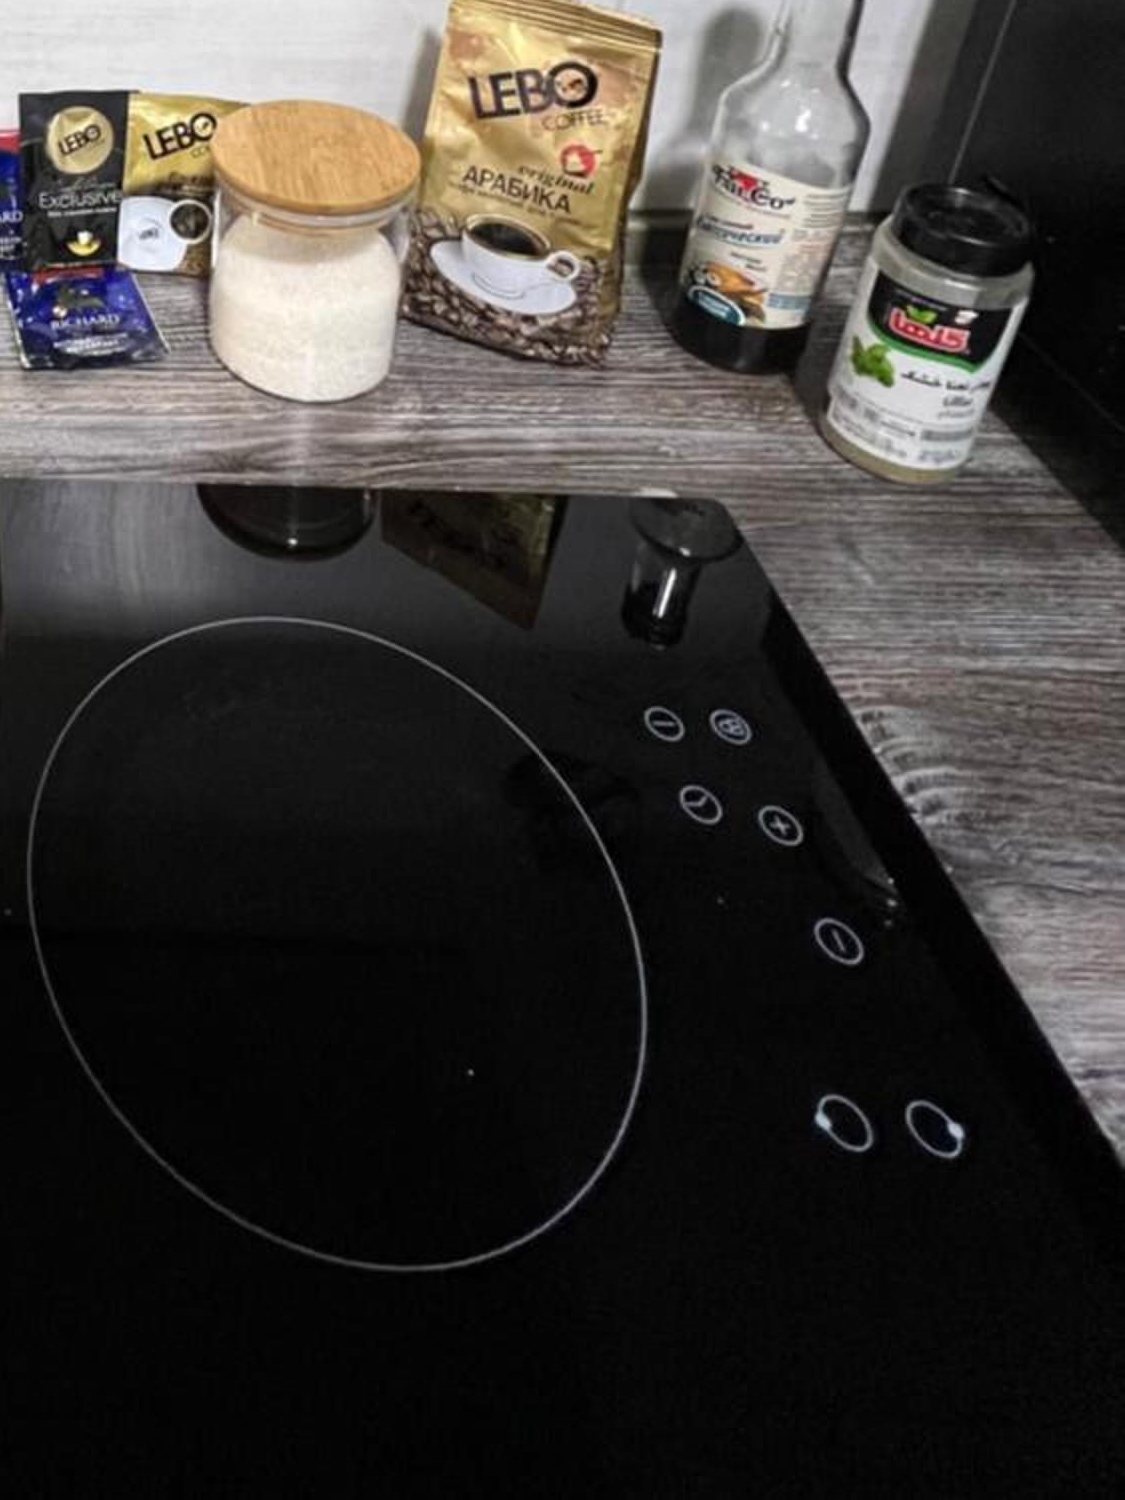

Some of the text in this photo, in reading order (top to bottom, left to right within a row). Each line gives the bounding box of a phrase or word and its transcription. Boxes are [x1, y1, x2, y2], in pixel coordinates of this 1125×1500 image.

[468, 61, 598, 120] LEBO
[143, 112, 218, 160] LEBO
[542, 109, 604, 131] COFFEE
[58, 124, 102, 156] LEBO
[38, 190, 123, 209] Exclusive
[462, 165, 572, 213] АРАБИКА
[50, 313, 121, 331] RICHARD
